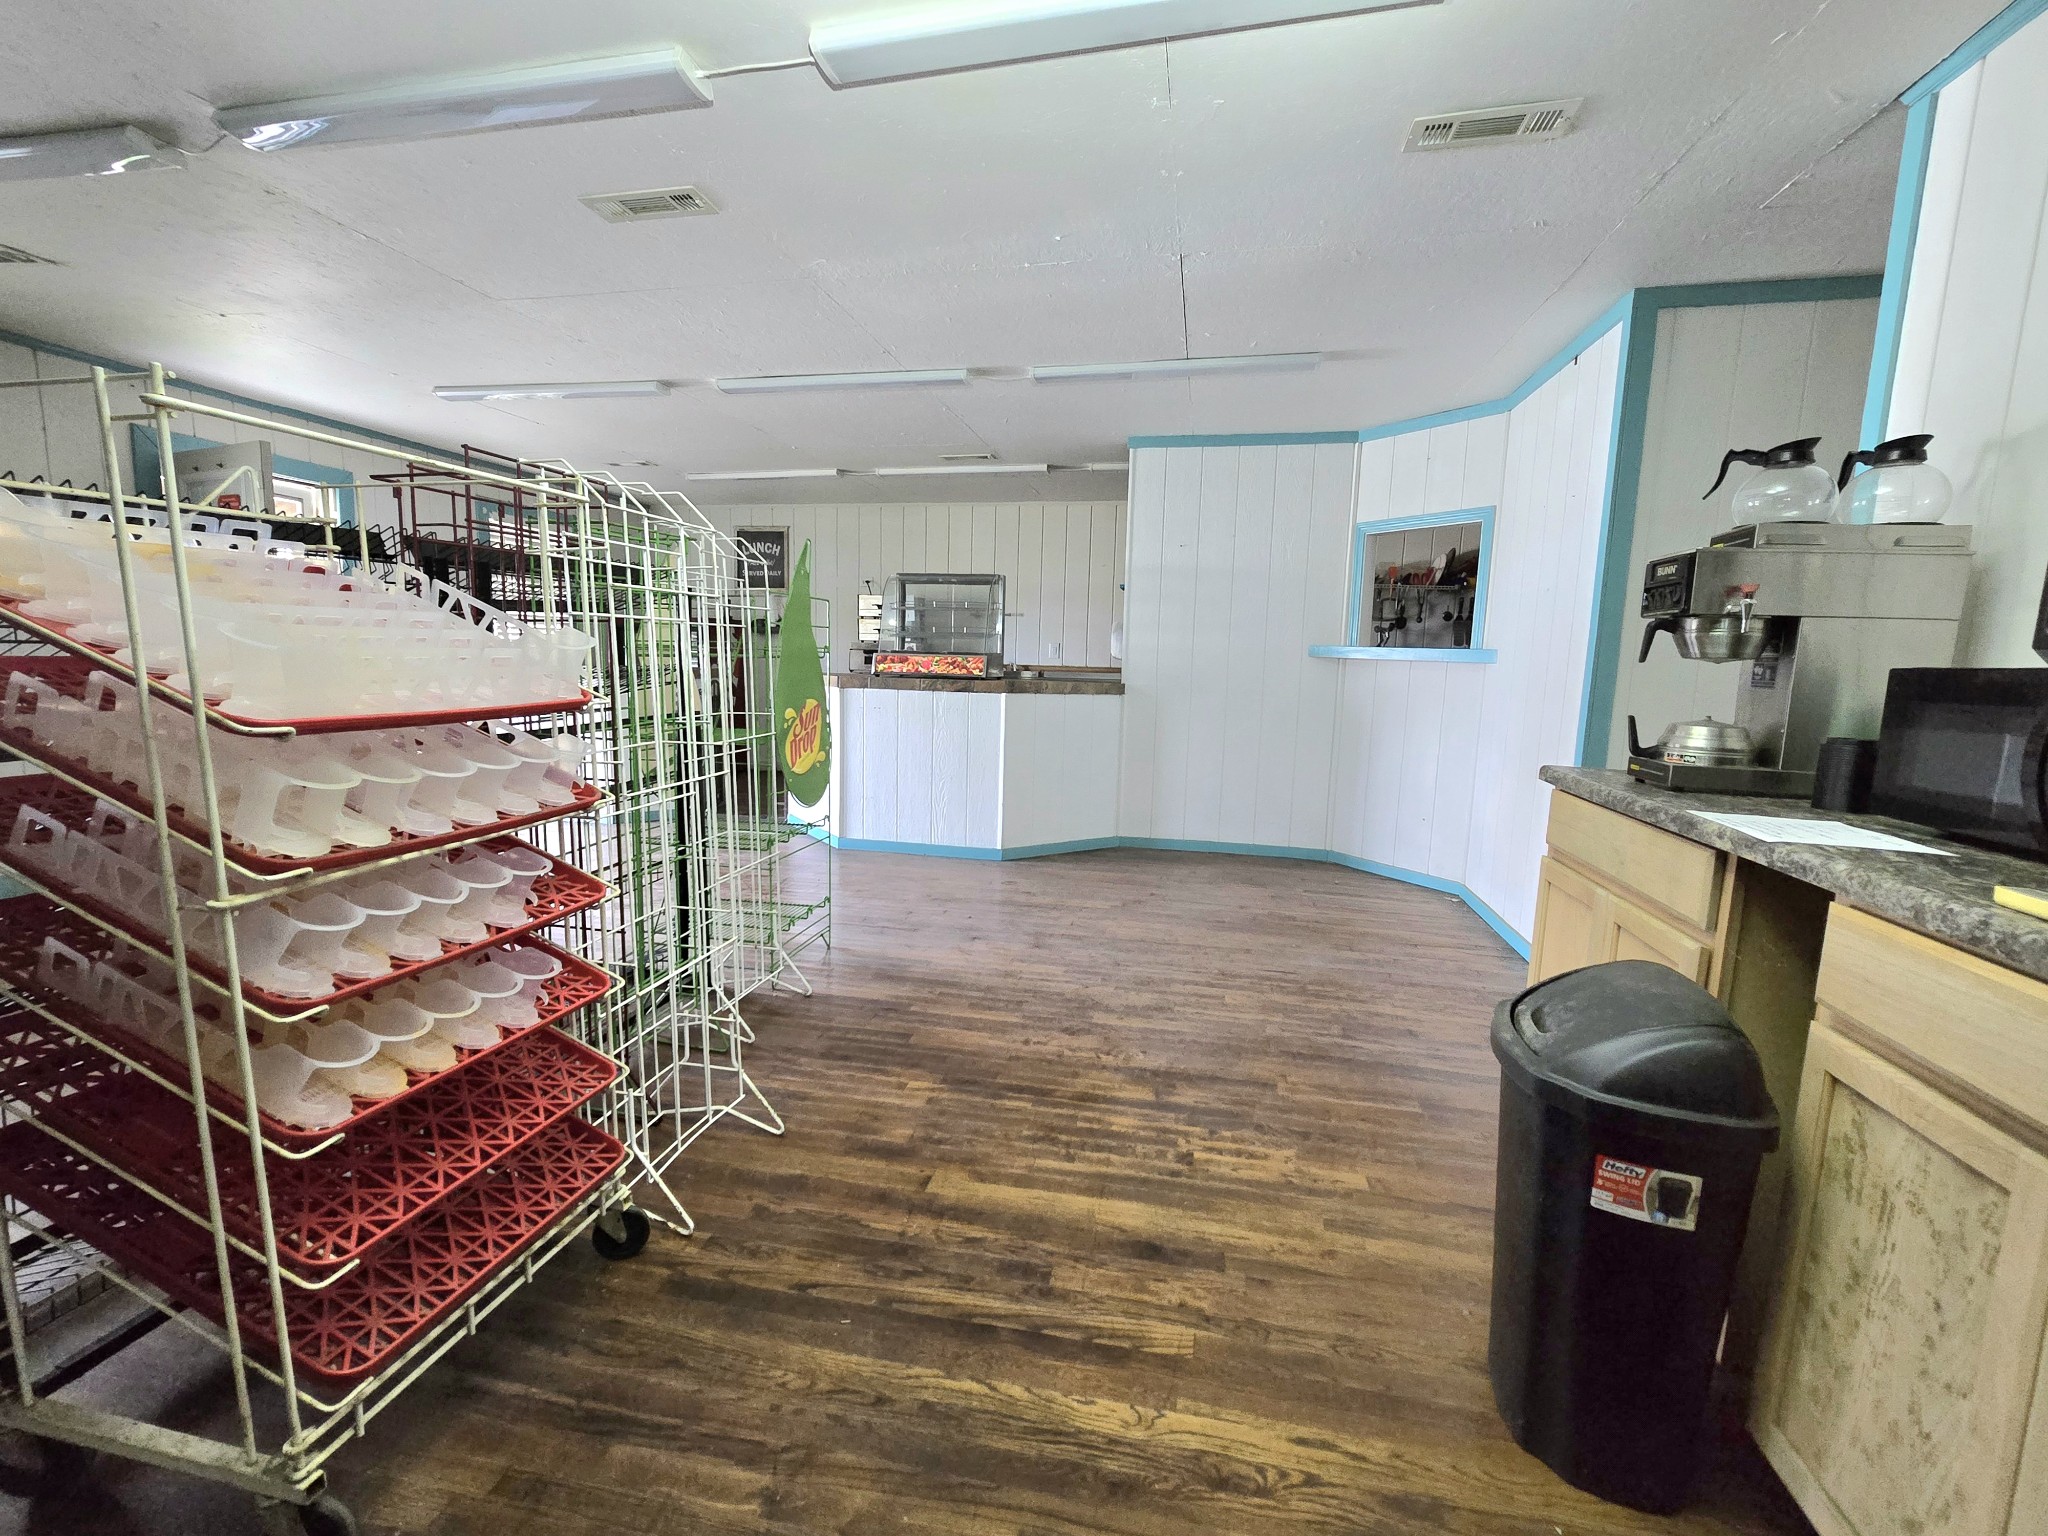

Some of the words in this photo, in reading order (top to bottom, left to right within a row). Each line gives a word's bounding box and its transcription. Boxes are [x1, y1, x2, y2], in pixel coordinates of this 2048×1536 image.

[742, 542, 780, 556] LUNCH
[793, 703, 820, 738] Sun
[790, 725, 816, 768] Drop
[1598, 1169, 1626, 1183] SWING
[1627, 1177, 1641, 1187] LID
[1605, 1161, 1643, 1178] Hefty
